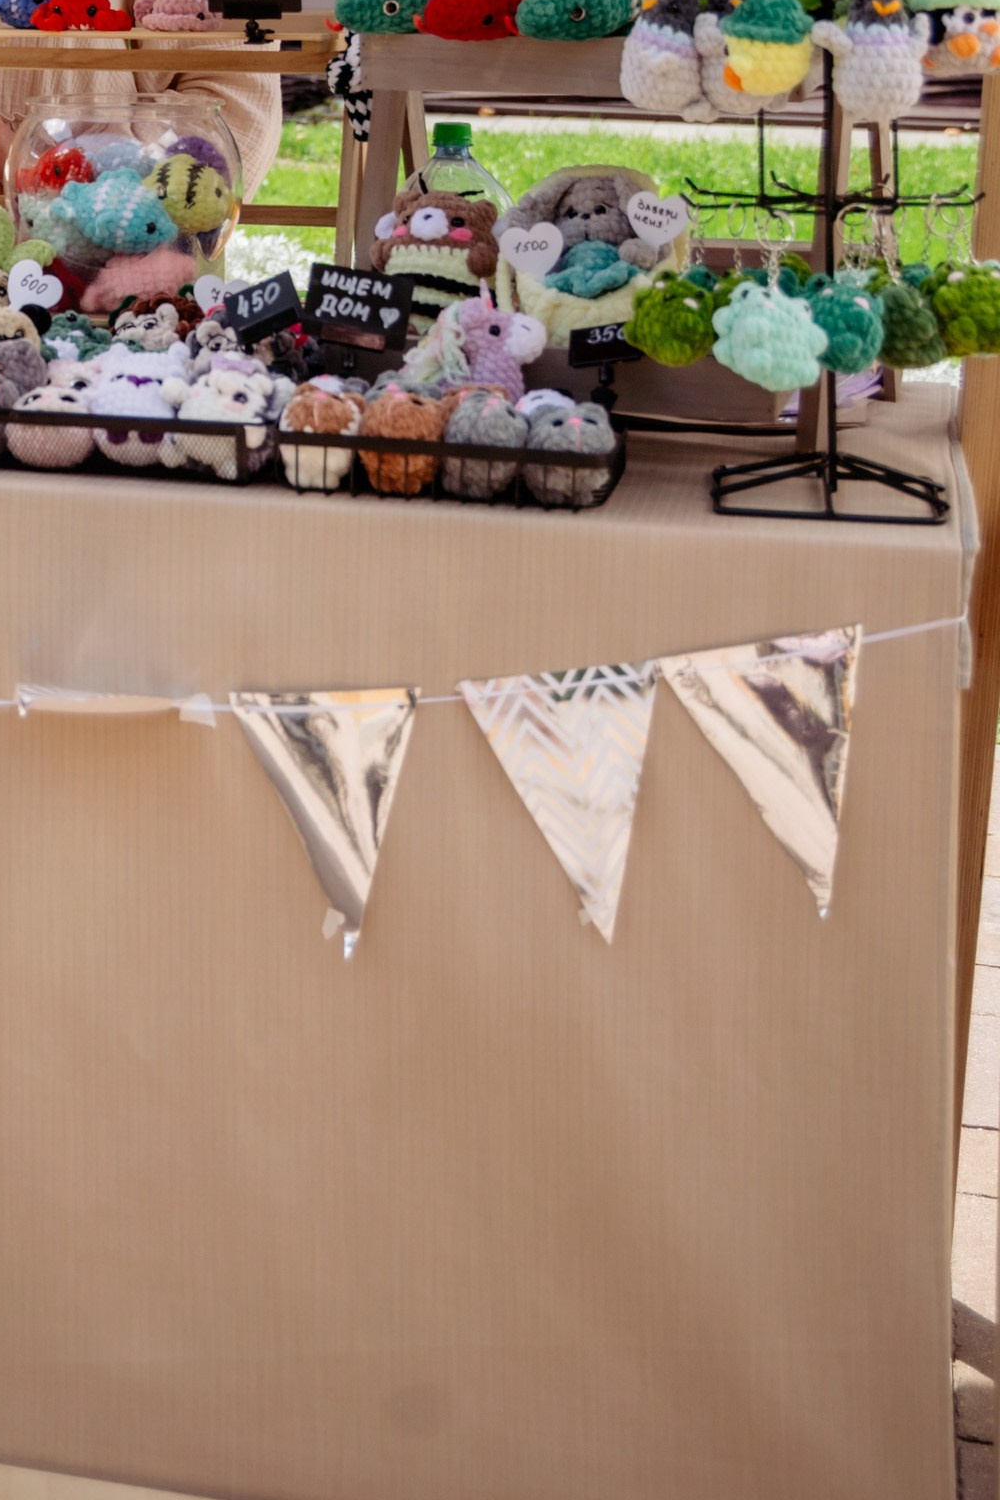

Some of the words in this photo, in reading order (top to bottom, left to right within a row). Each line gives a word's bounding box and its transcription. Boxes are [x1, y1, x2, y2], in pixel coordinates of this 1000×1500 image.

[514, 240, 549, 254] 1500
[20, 273, 49, 295] 600
[320, 269, 393, 300] ИЩЕМ
[236, 281, 281, 319] 450
[314, 293, 371, 323] ДОМ
